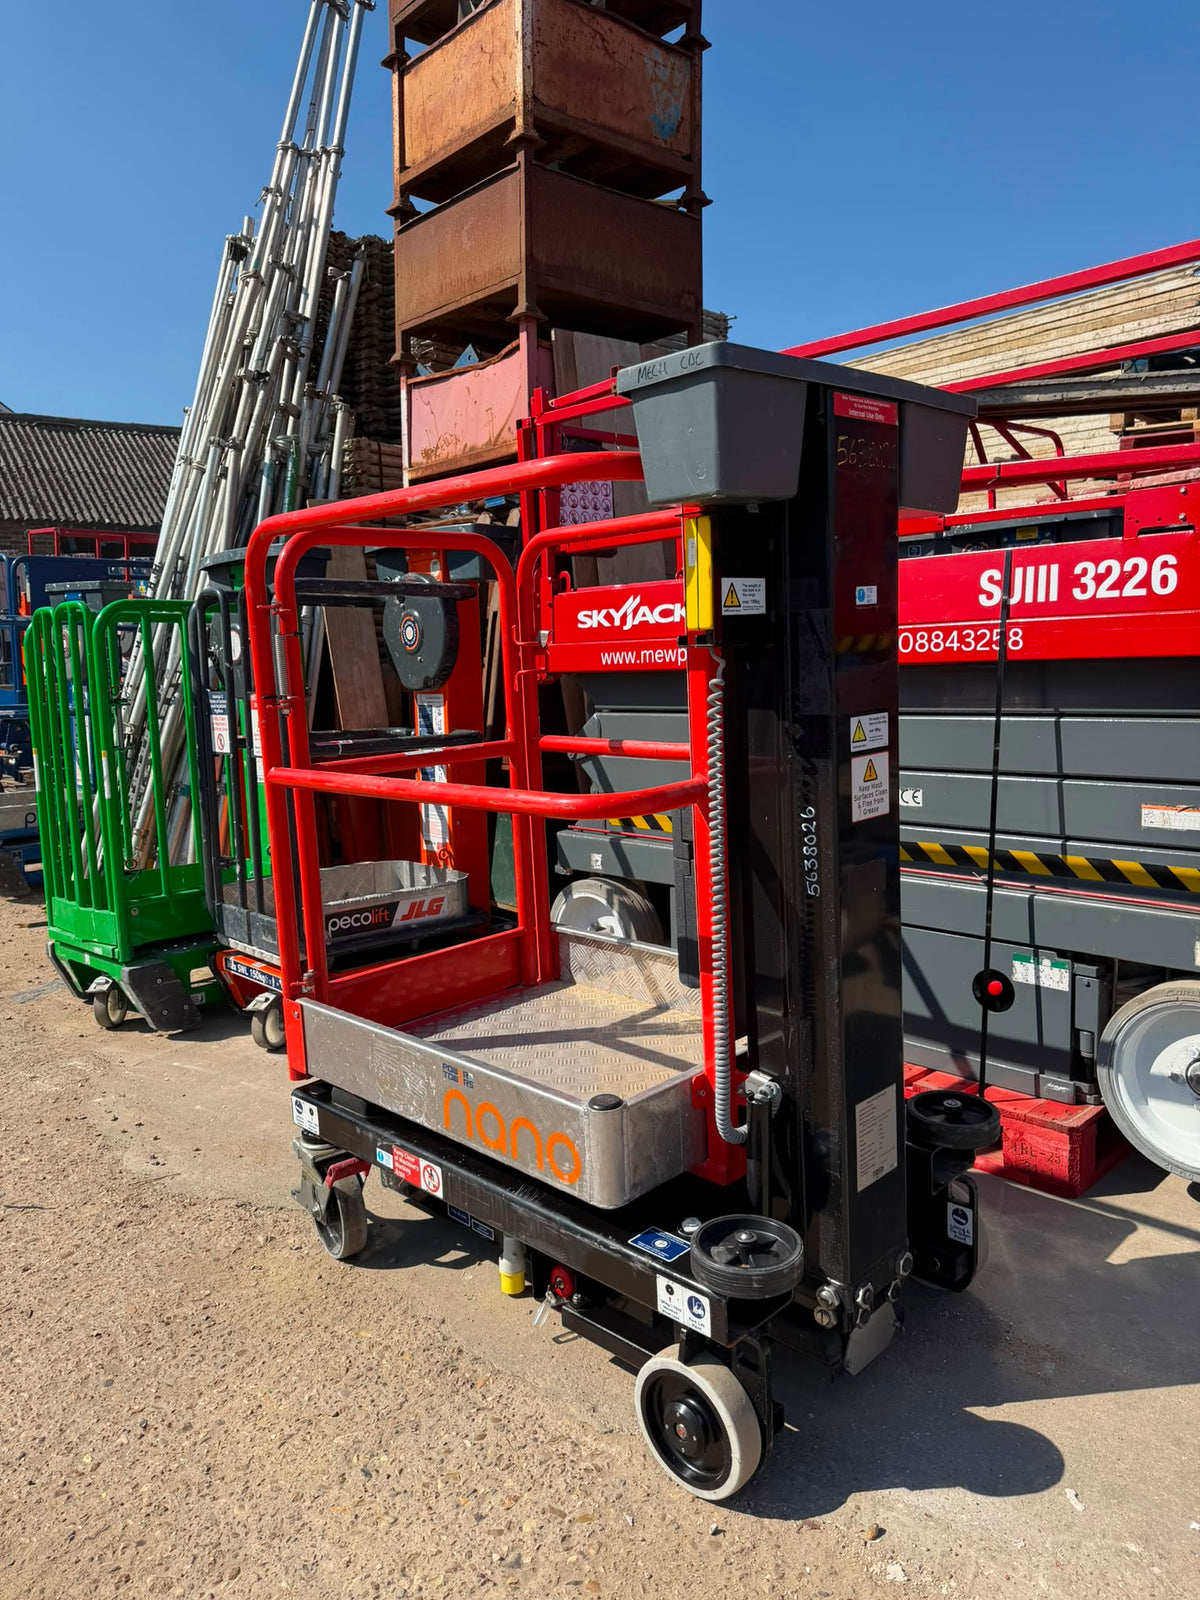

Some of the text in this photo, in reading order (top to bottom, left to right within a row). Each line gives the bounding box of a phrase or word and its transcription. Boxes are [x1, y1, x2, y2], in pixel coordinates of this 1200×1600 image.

[849, 408, 885, 422] Internal Use Only
[1072, 554, 1178, 600] 3226
[577, 595, 686, 630] SKYJACK
[601, 647, 688, 666] www.mewp
[854, 788, 888, 802] Surfaces Clean
[859, 781, 882, 793] Keep Mast
[862, 800, 873, 808] Free
[874, 796, 884, 806] from
[863, 806, 879, 816] Grease
[800, 806, 820, 897] 5638026
[400, 896, 445, 922] JLG
[328, 907, 390, 939] pecolift
[443, 1088, 582, 1185] nano
